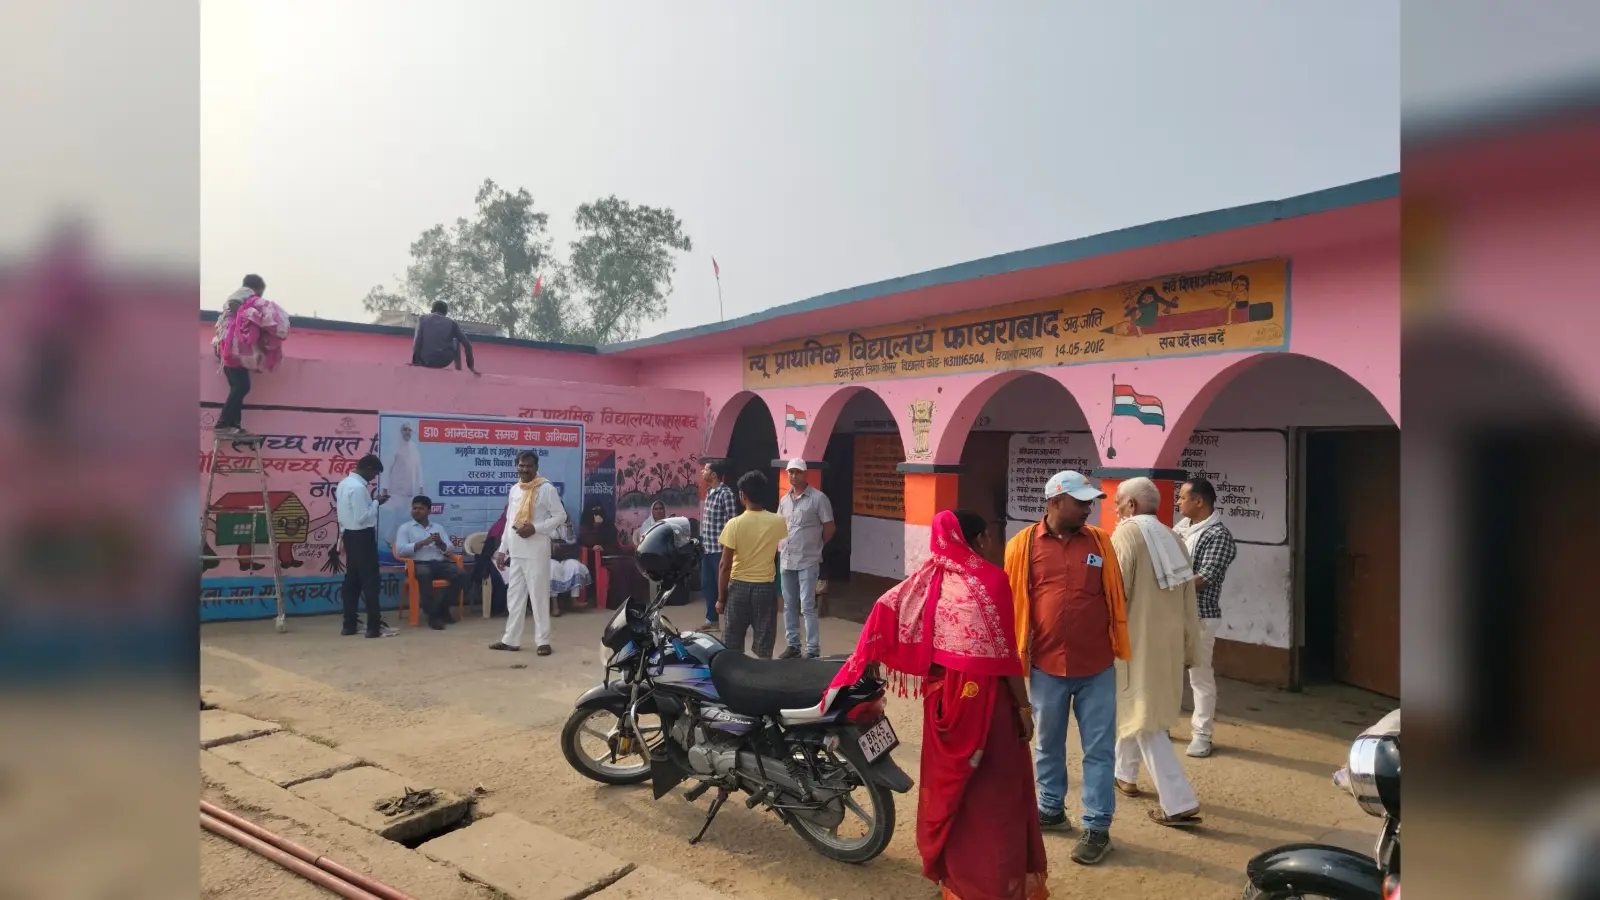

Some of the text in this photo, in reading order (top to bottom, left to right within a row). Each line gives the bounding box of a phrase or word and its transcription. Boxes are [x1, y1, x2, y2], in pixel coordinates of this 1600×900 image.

[748, 353, 770, 379] न्यू
[774, 339, 843, 374] प्राथमिक
[941, 308, 1064, 350] फाखराबाद
[444, 424, 490, 441] आम्बेडकर
[524, 427, 541, 441] सेवा
[545, 429, 578, 443] अभियान
[312, 436, 364, 456] भारत
[467, 470, 496, 480] सरकार
[1216, 480, 1246, 494] अधिकार
[1221, 493, 1251, 506] अधिकार
[865, 723, 885, 744] BR45
[869, 732, 893, 757] M3115
